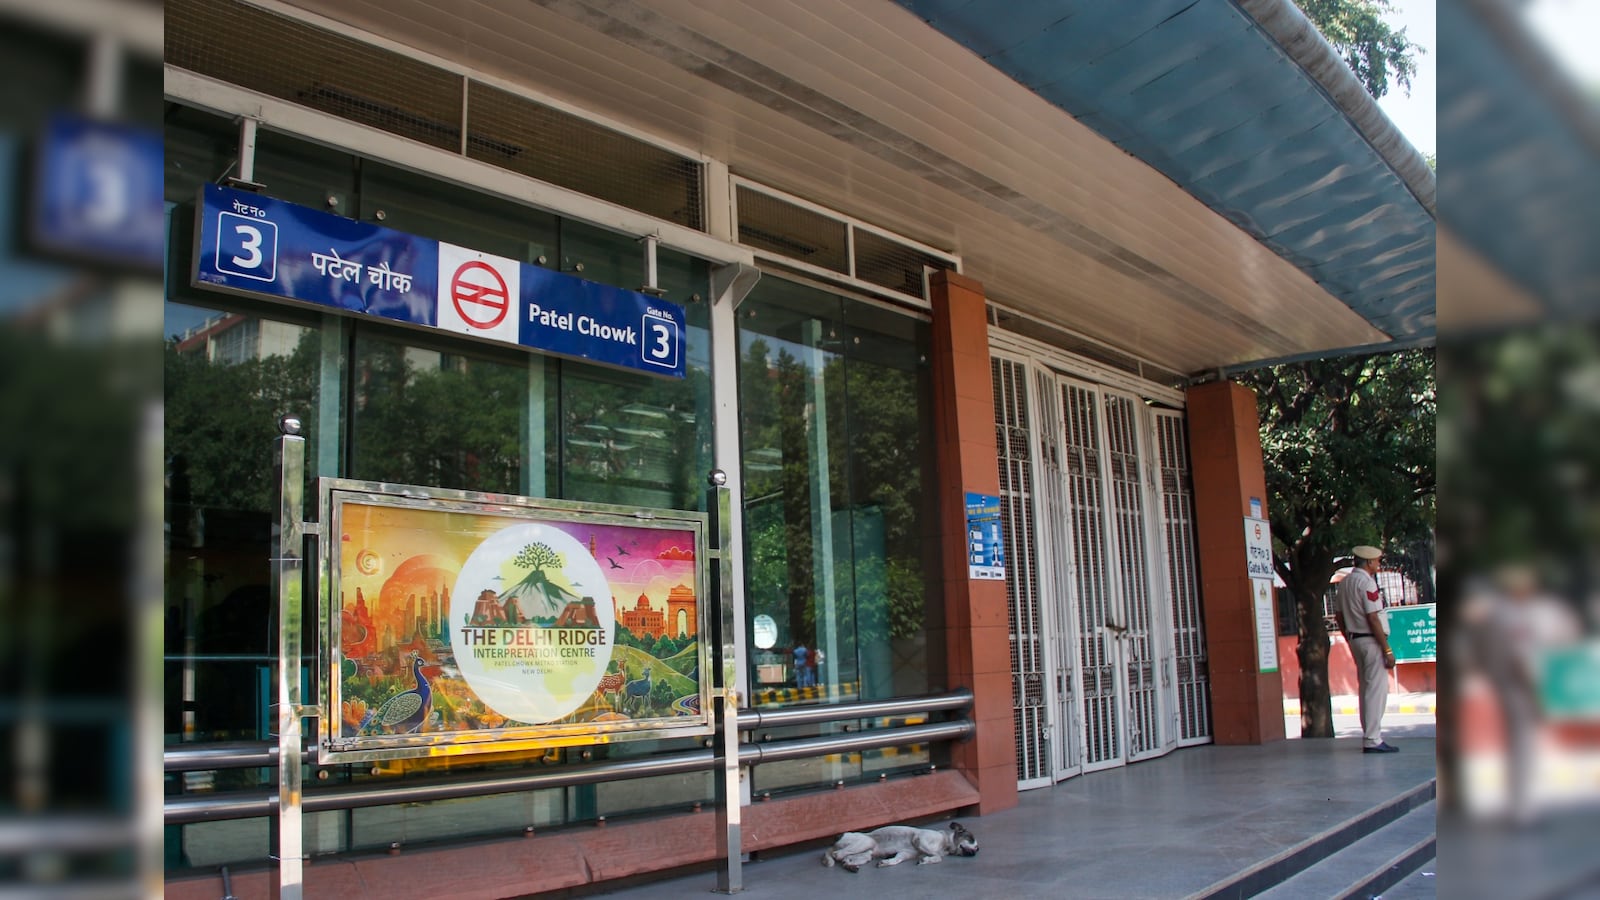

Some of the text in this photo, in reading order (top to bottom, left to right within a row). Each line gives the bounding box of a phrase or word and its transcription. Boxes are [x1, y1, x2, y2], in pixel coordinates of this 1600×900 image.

[233, 199, 248, 215] गेट
[232, 225, 263, 269] 3
[311, 248, 412, 293] पटेल चौक
[647, 307, 674, 320] Gate No.
[529, 303, 636, 345] Patel Chowk
[652, 324, 670, 358] 3
[1248, 560, 1261, 574] Gate
[461, 629, 606, 645] THE DELHI RIDGE
[473, 647, 595, 658] INTERPRETATION CENTRE
